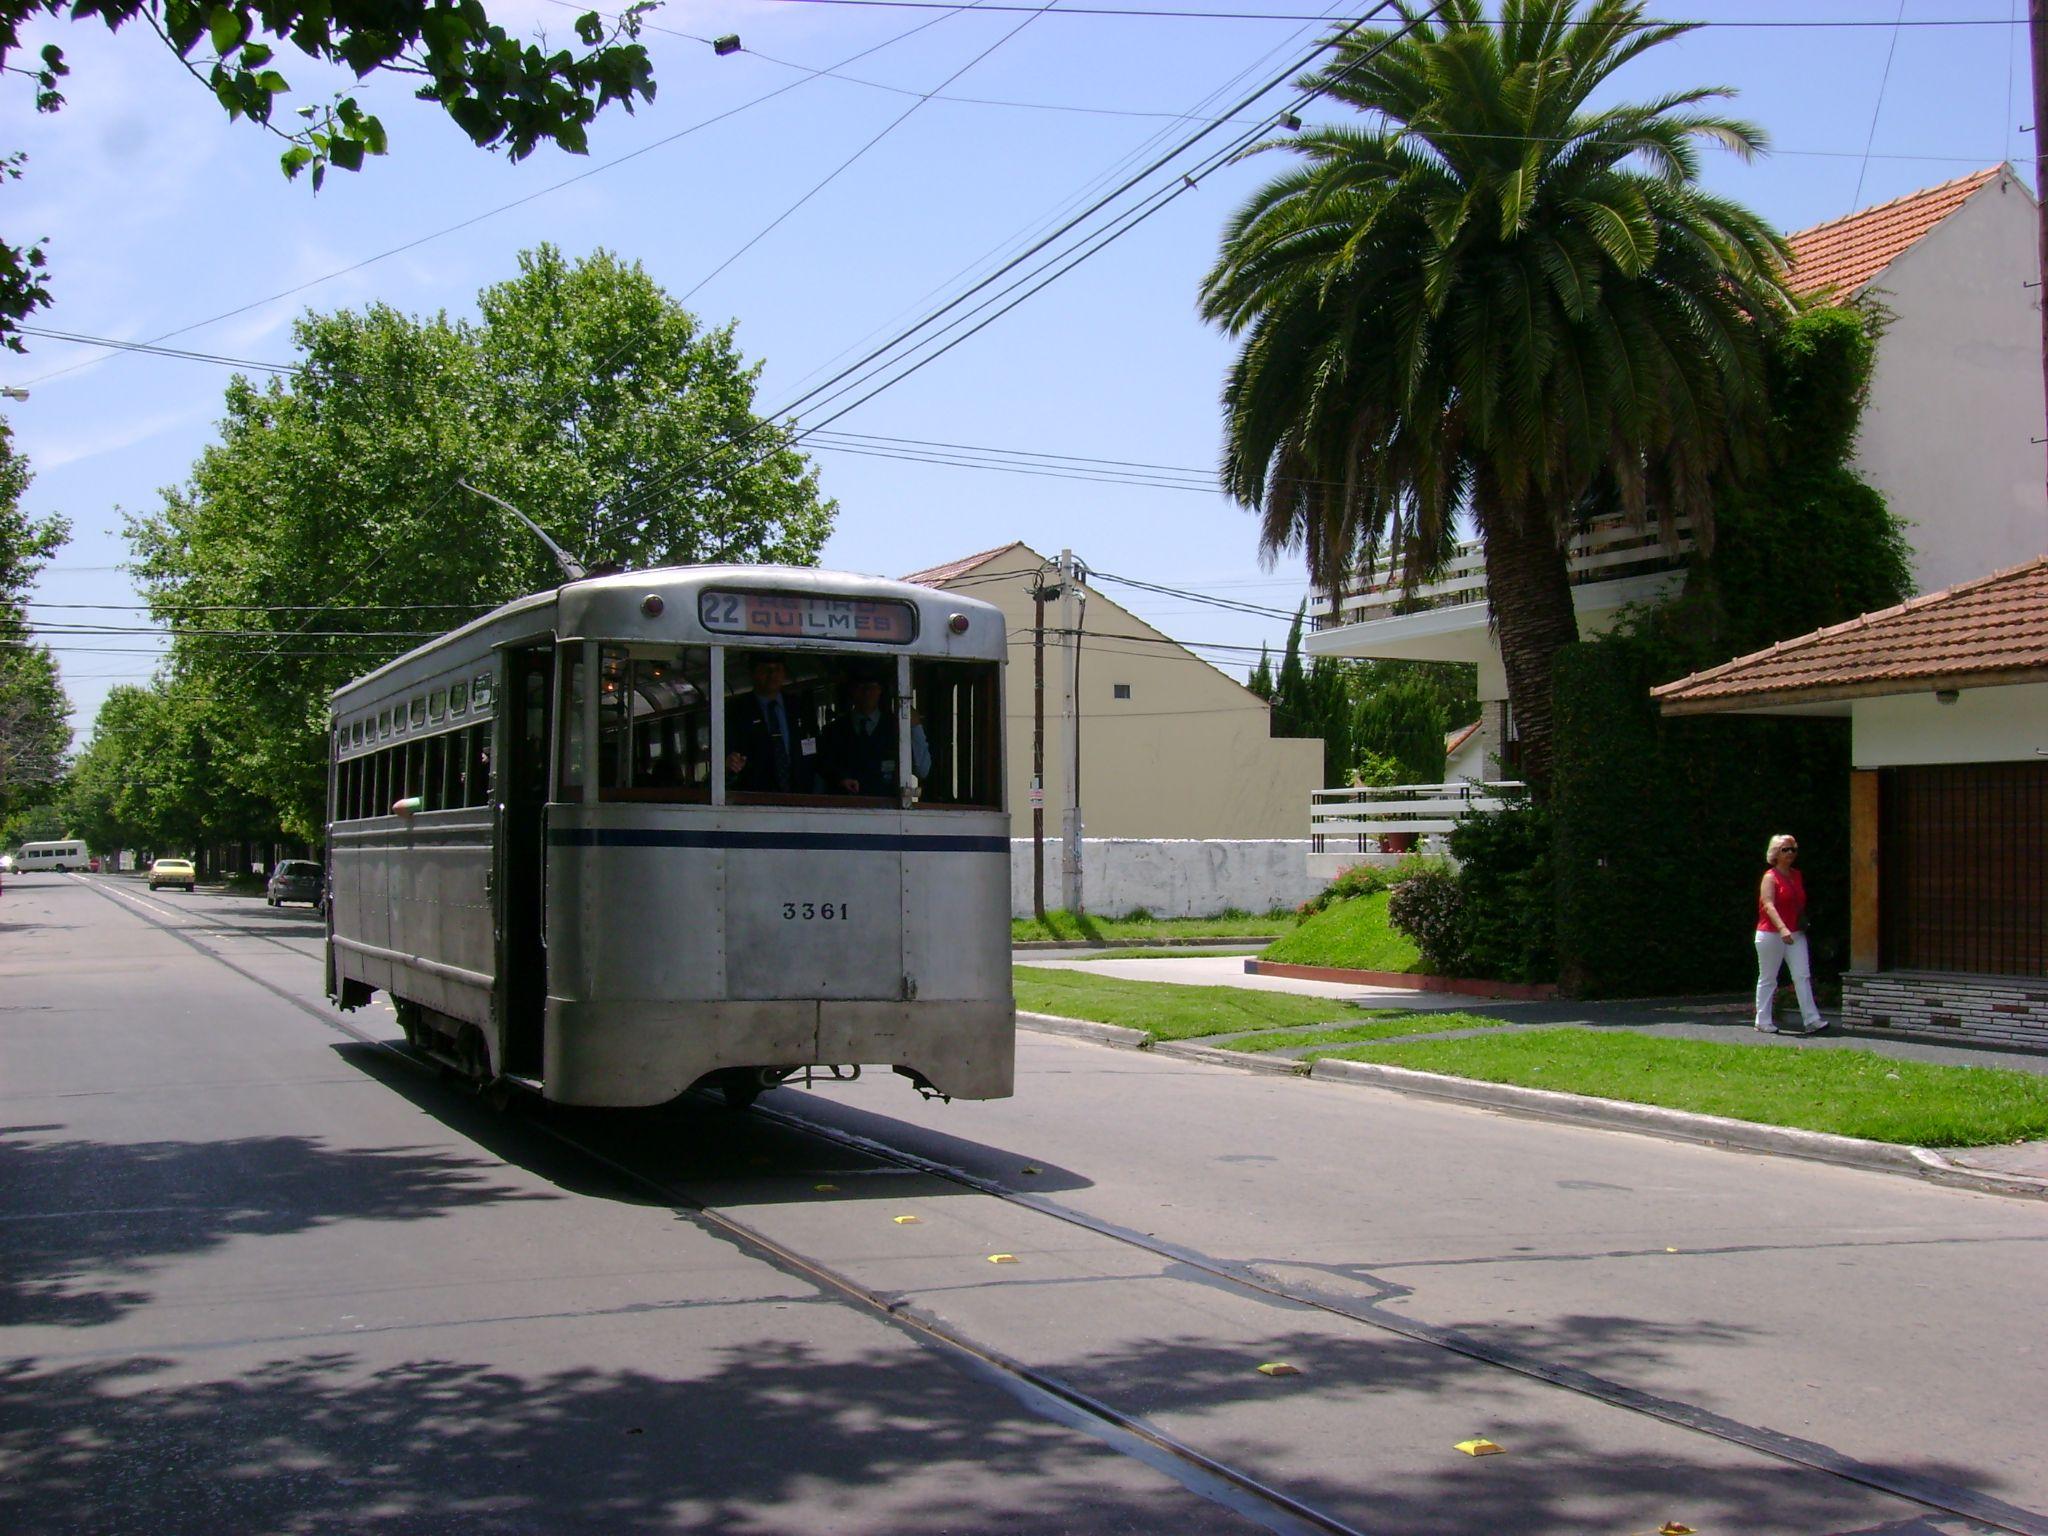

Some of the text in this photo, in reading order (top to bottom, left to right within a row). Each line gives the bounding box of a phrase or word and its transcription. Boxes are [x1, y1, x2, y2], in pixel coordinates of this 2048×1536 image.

[703, 594, 739, 623] 22
[751, 610, 891, 631] QUILMES
[783, 903, 847, 920] 3361
